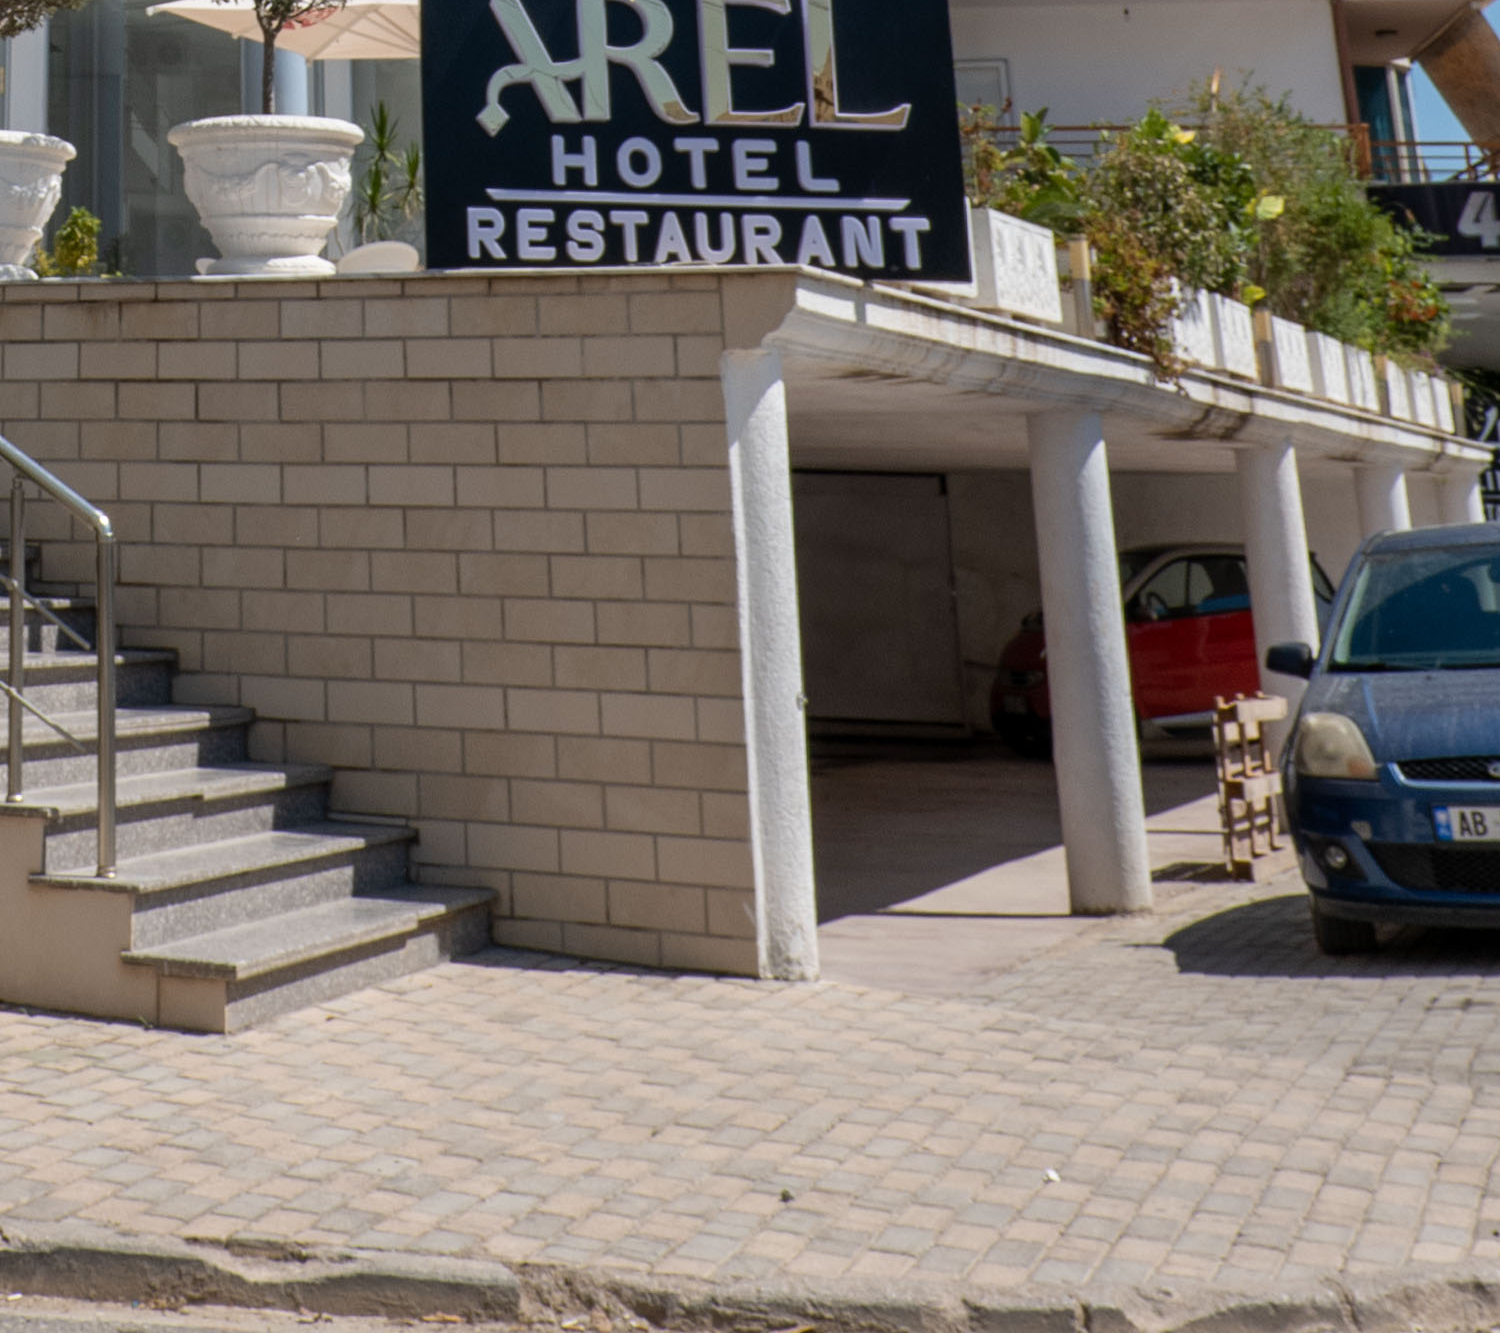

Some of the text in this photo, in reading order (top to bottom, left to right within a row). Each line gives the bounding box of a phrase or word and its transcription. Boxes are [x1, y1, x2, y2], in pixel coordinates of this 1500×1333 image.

[550, 134, 840, 193] HOTEL
[465, 206, 931, 271] RESTAURANT
[1457, 810, 1488, 837] AB
